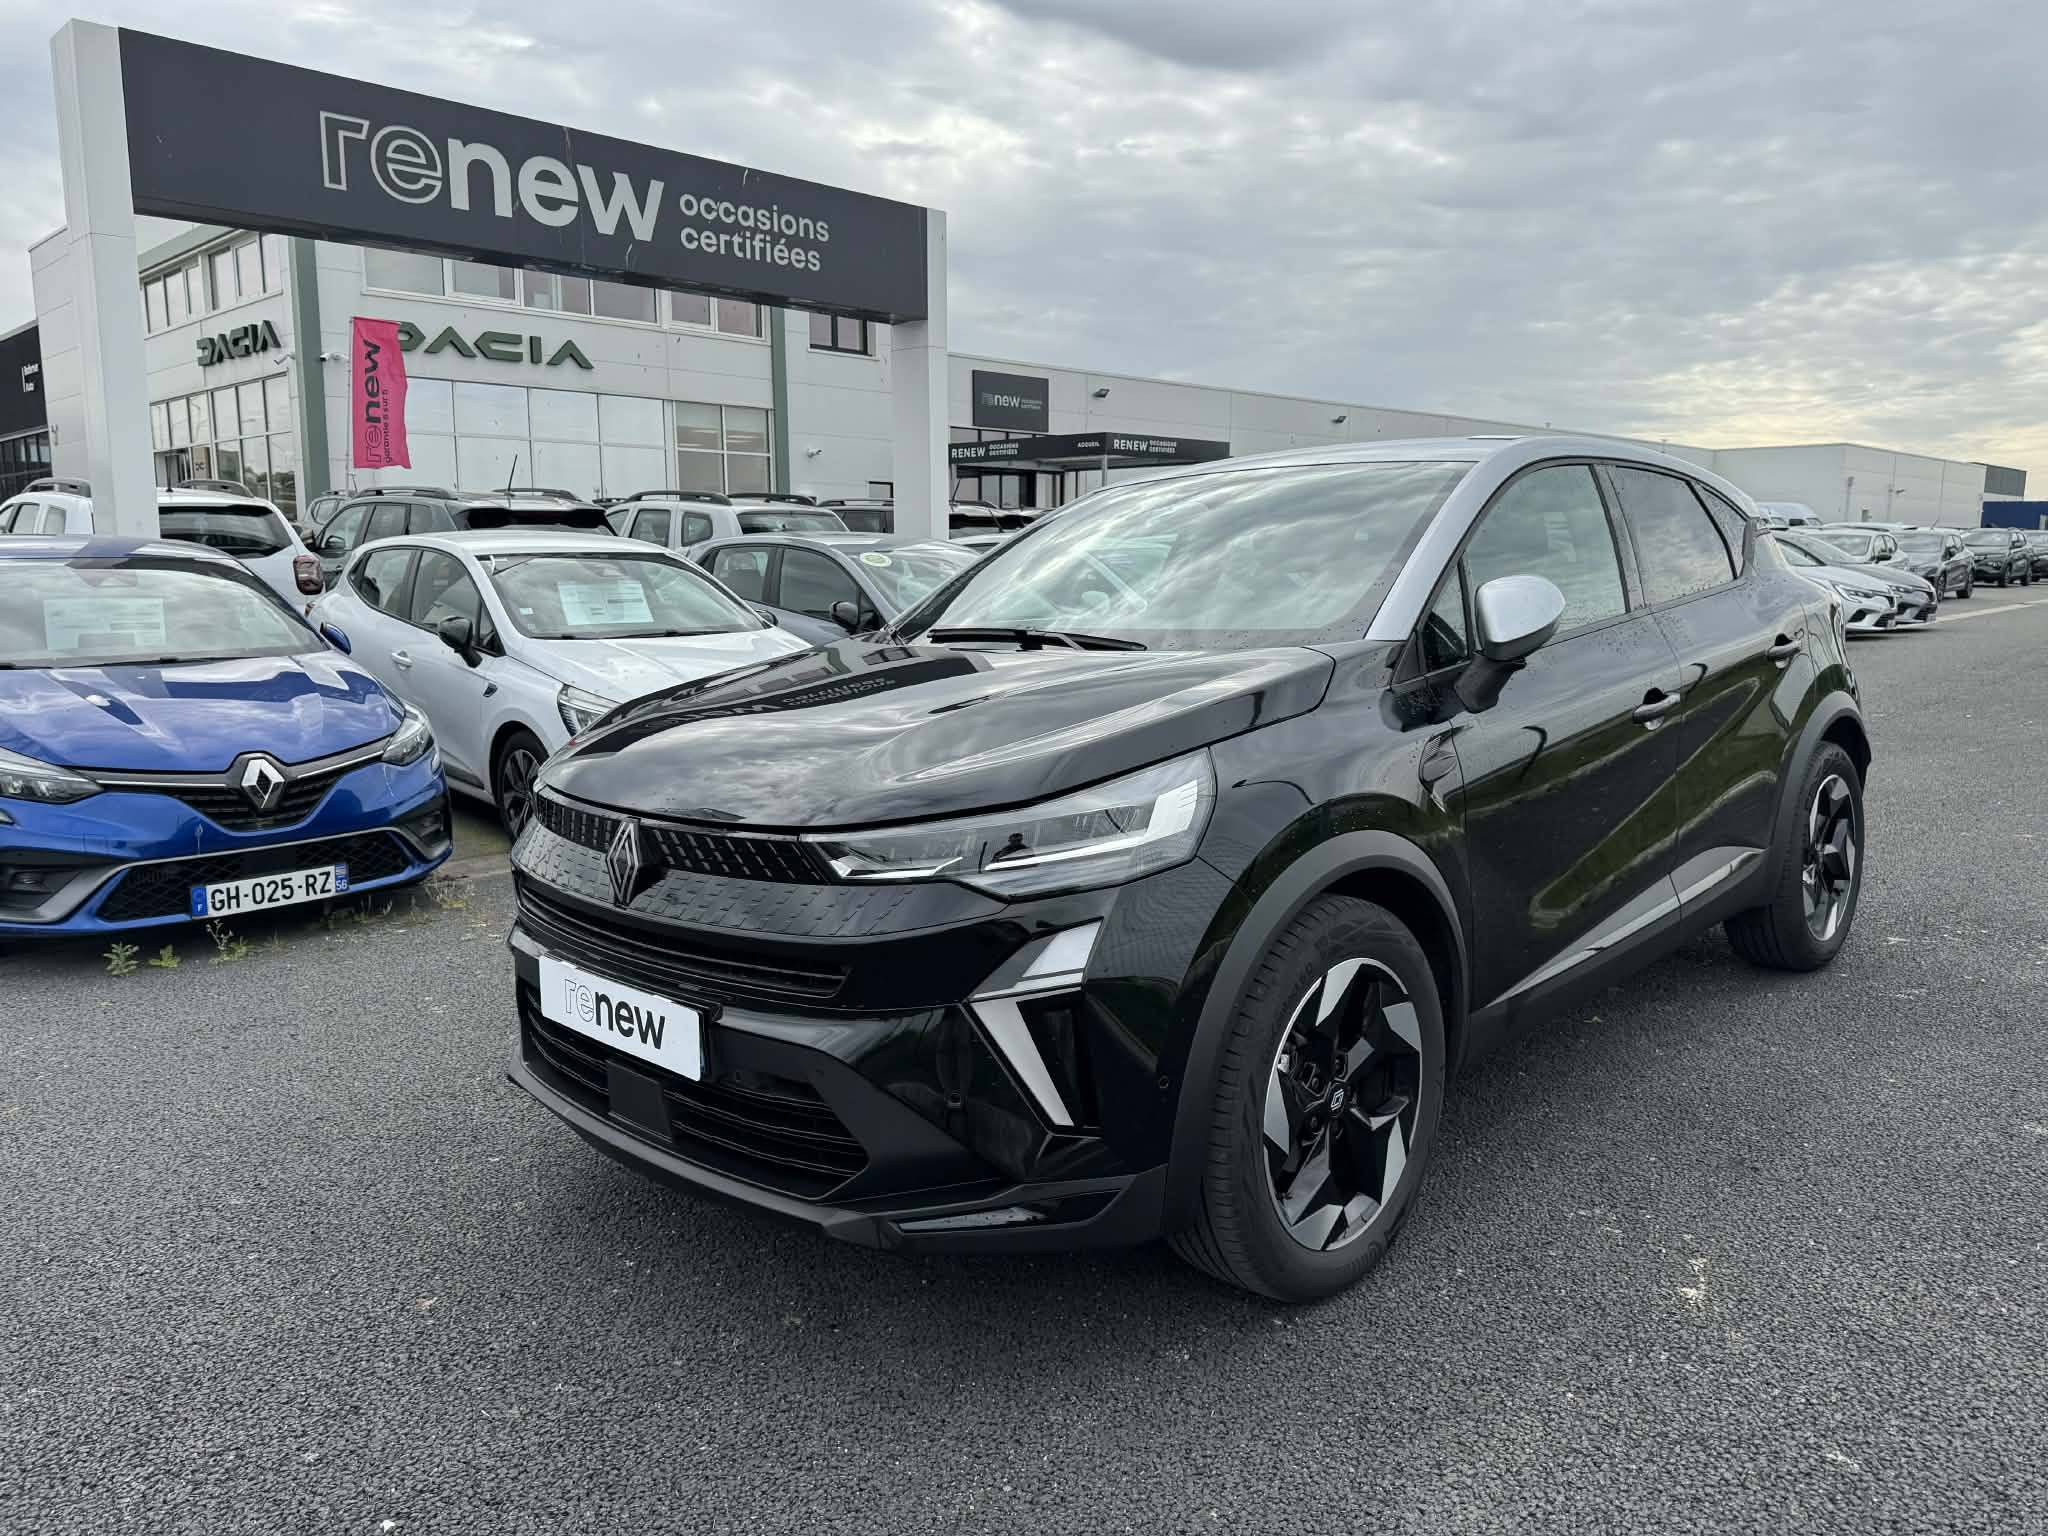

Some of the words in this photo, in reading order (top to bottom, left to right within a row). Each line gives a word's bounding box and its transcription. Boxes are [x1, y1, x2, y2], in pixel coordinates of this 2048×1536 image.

[320, 110, 664, 242] renew
[679, 193, 830, 242] occasions
[680, 226, 822, 272] certifiées
[196, 320, 281, 367] DACIA
[398, 321, 594, 370] DACIA
[363, 339, 382, 464] renew
[951, 446, 986, 459] RENEW
[1113, 439, 1148, 452] RENEW
[210, 871, 332, 912] GH-025-RZ
[564, 978, 666, 1050] renew
